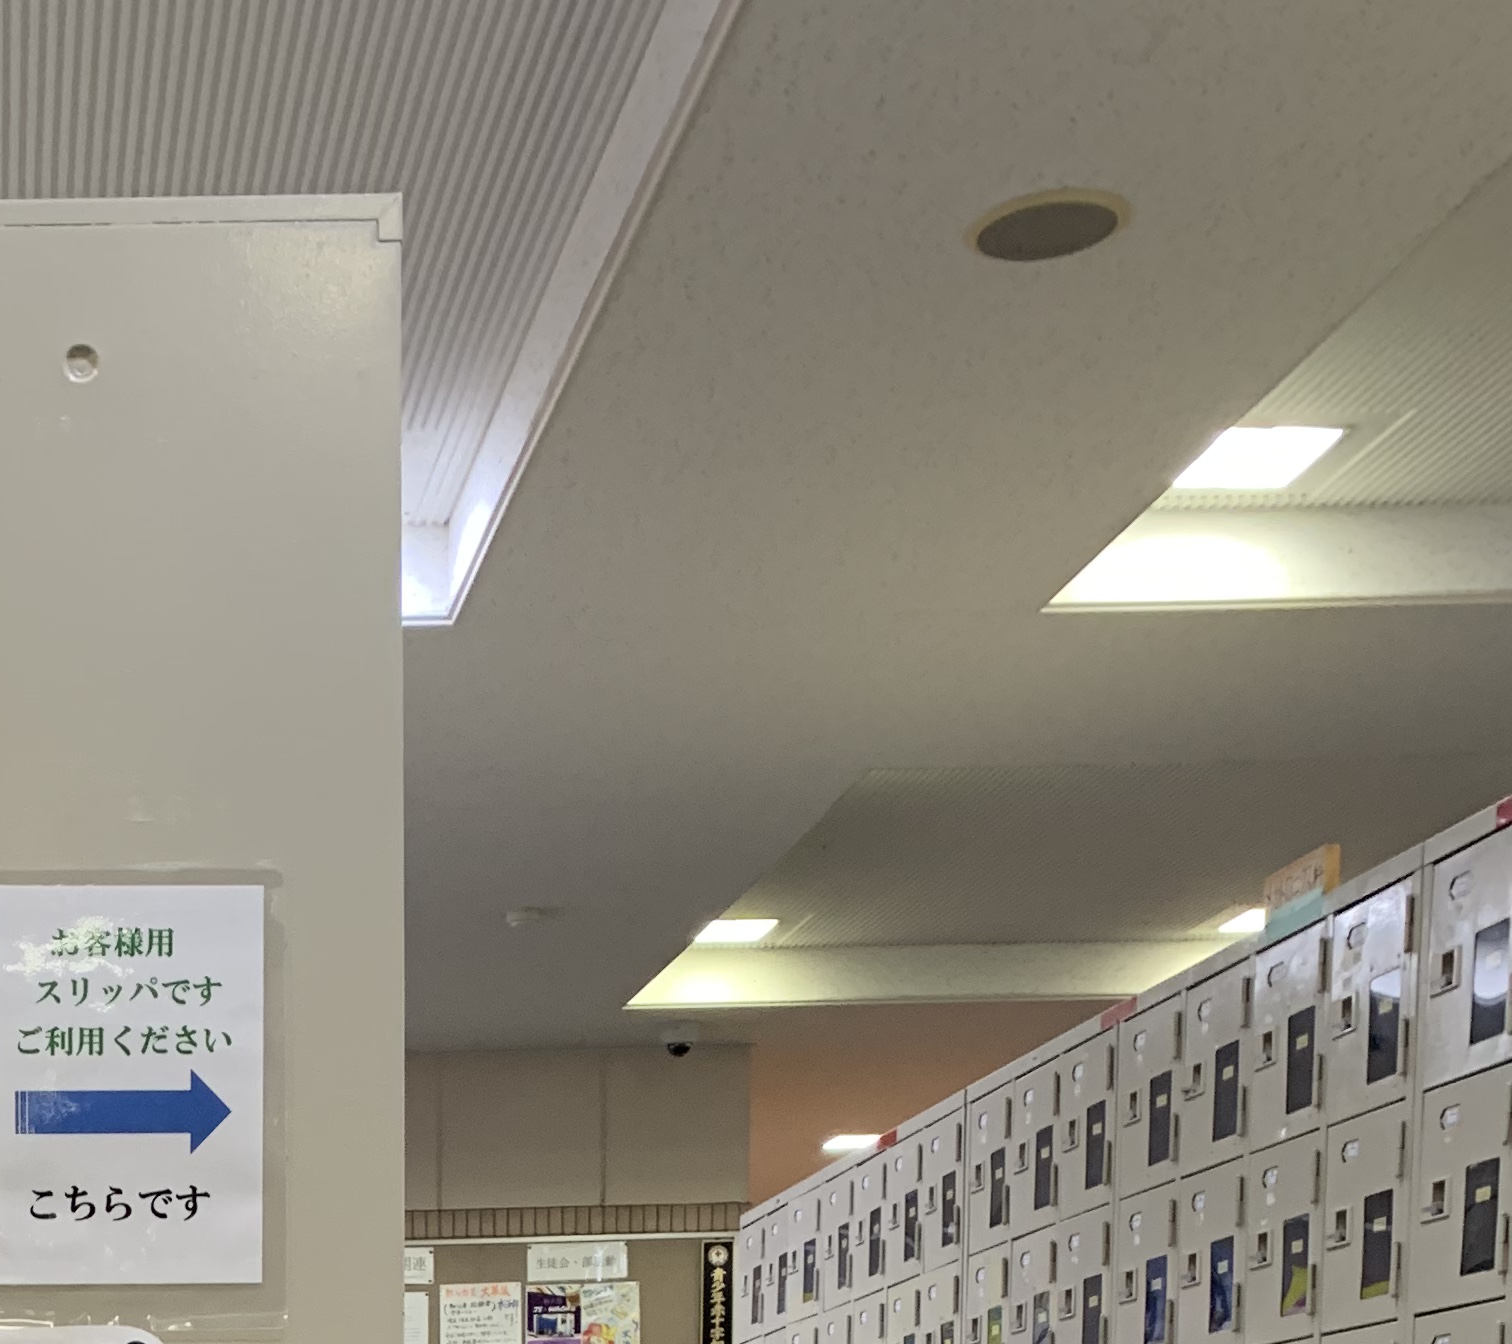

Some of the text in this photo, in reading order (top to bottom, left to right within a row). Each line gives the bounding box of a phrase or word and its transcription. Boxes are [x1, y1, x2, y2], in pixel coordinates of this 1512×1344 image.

[51, 927, 175, 958] お客様用
[36, 976, 222, 1006] スリッパです
[16, 1025, 232, 1057] ご利用ください
[29, 1185, 210, 1221] こちらです
